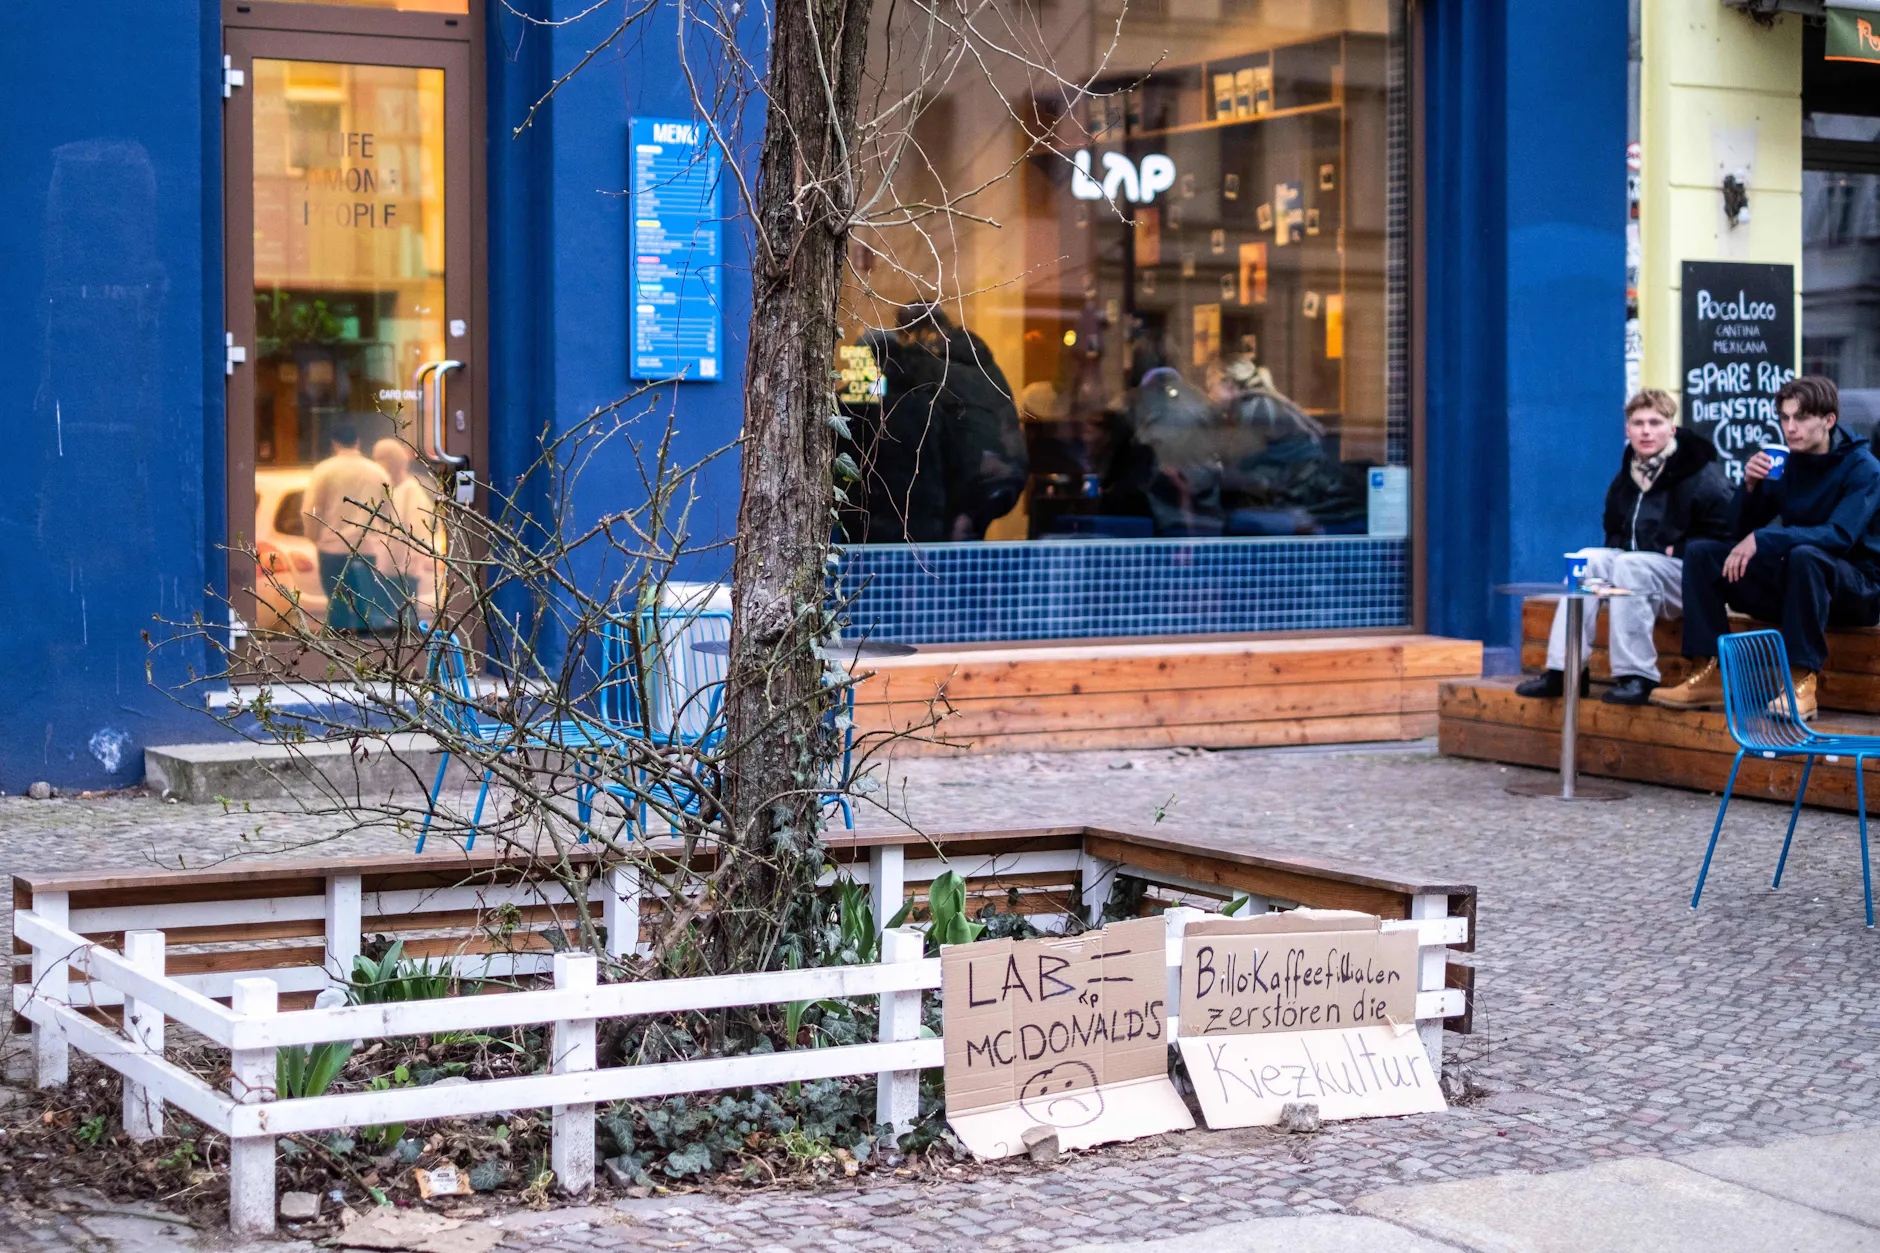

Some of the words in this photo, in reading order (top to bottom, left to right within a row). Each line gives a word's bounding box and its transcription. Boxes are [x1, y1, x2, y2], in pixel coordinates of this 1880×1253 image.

[326, 131, 375, 159] LIFE
[653, 123, 700, 147] MENU
[304, 166, 399, 194] MON
[1715, 325, 1761, 338] CANTINA
[1713, 340, 1768, 354] MEXICANA
[1687, 361, 1752, 395] SPARE
[379, 389, 402, 401] CARD
[403, 389, 423, 401] ONLY
[968, 953, 1076, 1009] LAB
[1203, 993, 1341, 1034] zerstören
[1353, 988, 1387, 1023] die
[1206, 1033, 1421, 1104] Kiezkultur
